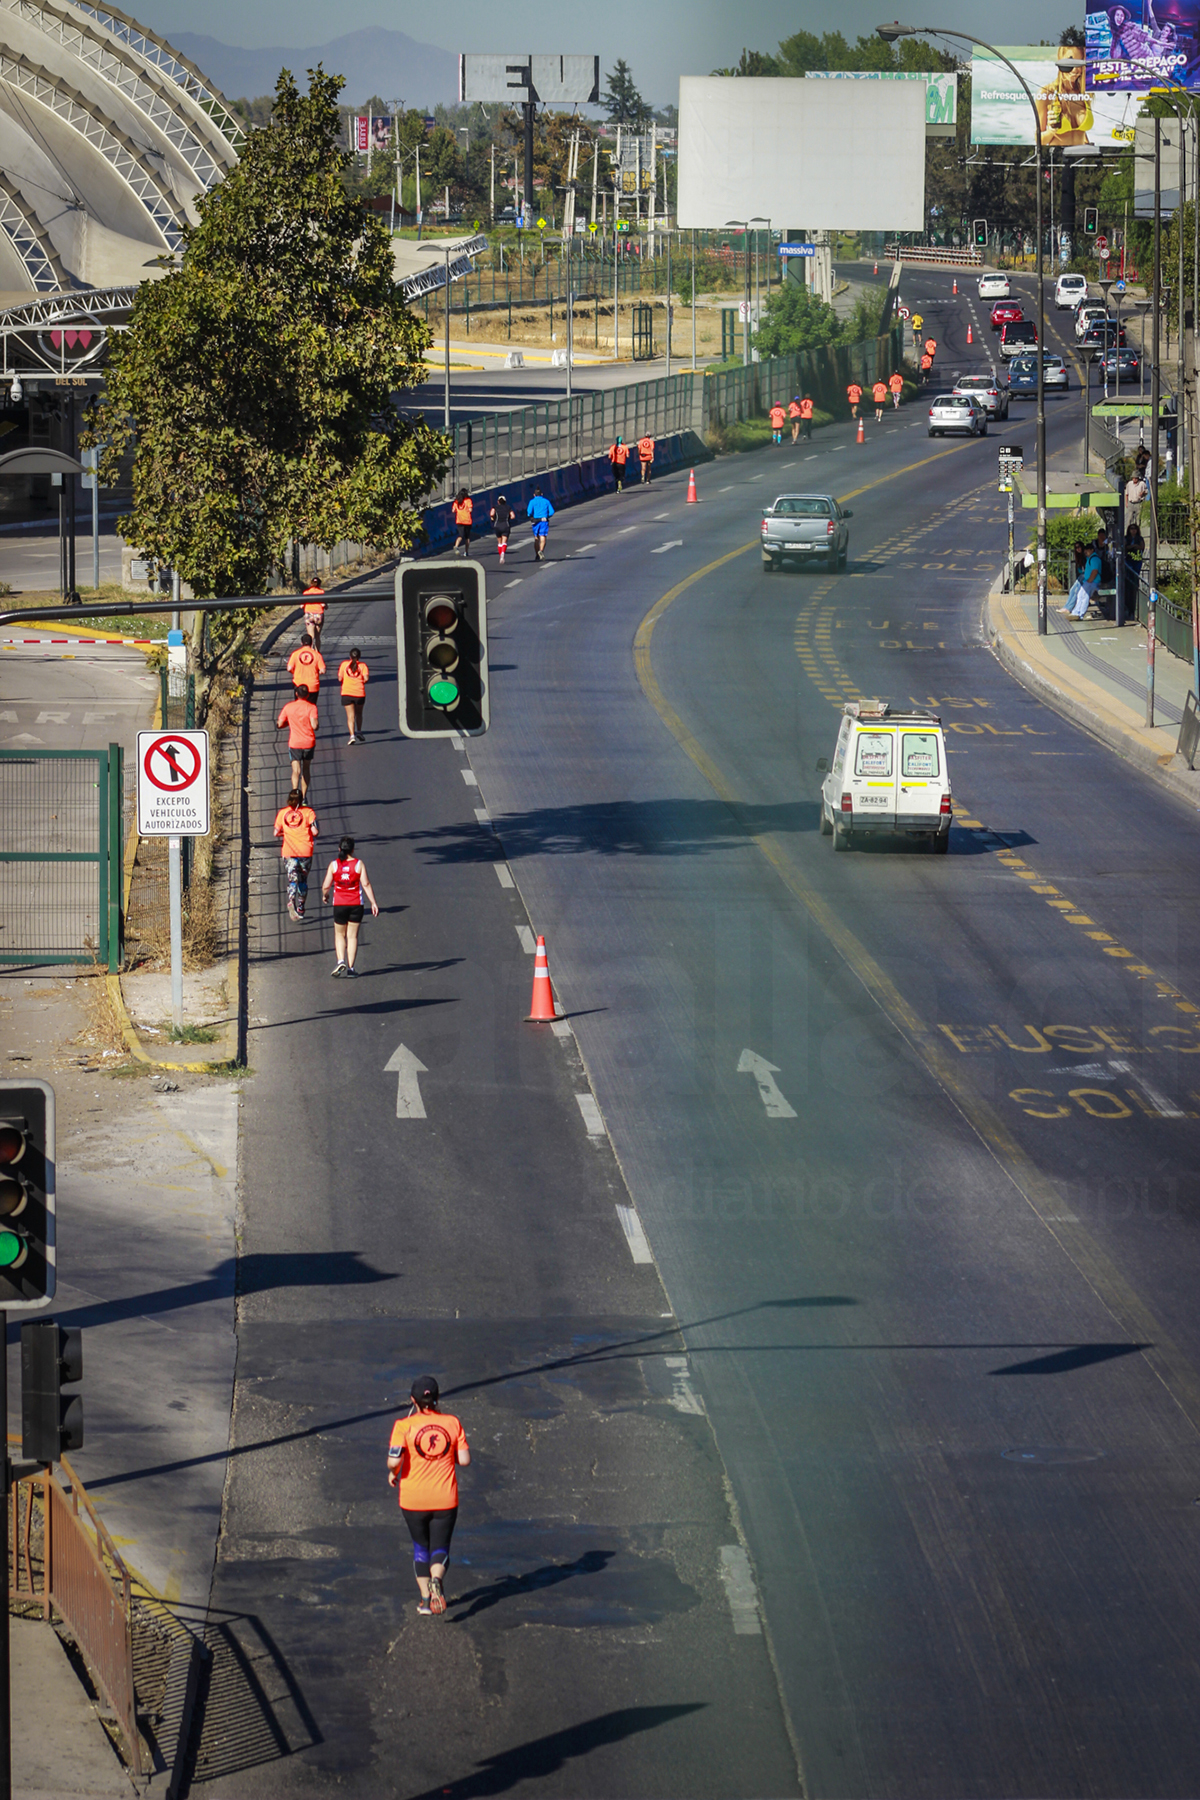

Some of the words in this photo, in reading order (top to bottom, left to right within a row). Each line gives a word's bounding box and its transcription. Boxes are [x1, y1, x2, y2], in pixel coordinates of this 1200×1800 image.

[1131, 54, 1188, 69] PREPAGO
[780, 245, 813, 254] massiva
[55, 378, 70, 386] DEL
[72, 378, 87, 386] SOL
[156, 797, 191, 806] EXCEPTO
[150, 808, 197, 817] VEHICULOS
[145, 820, 202, 829] AUTORIZADOS
